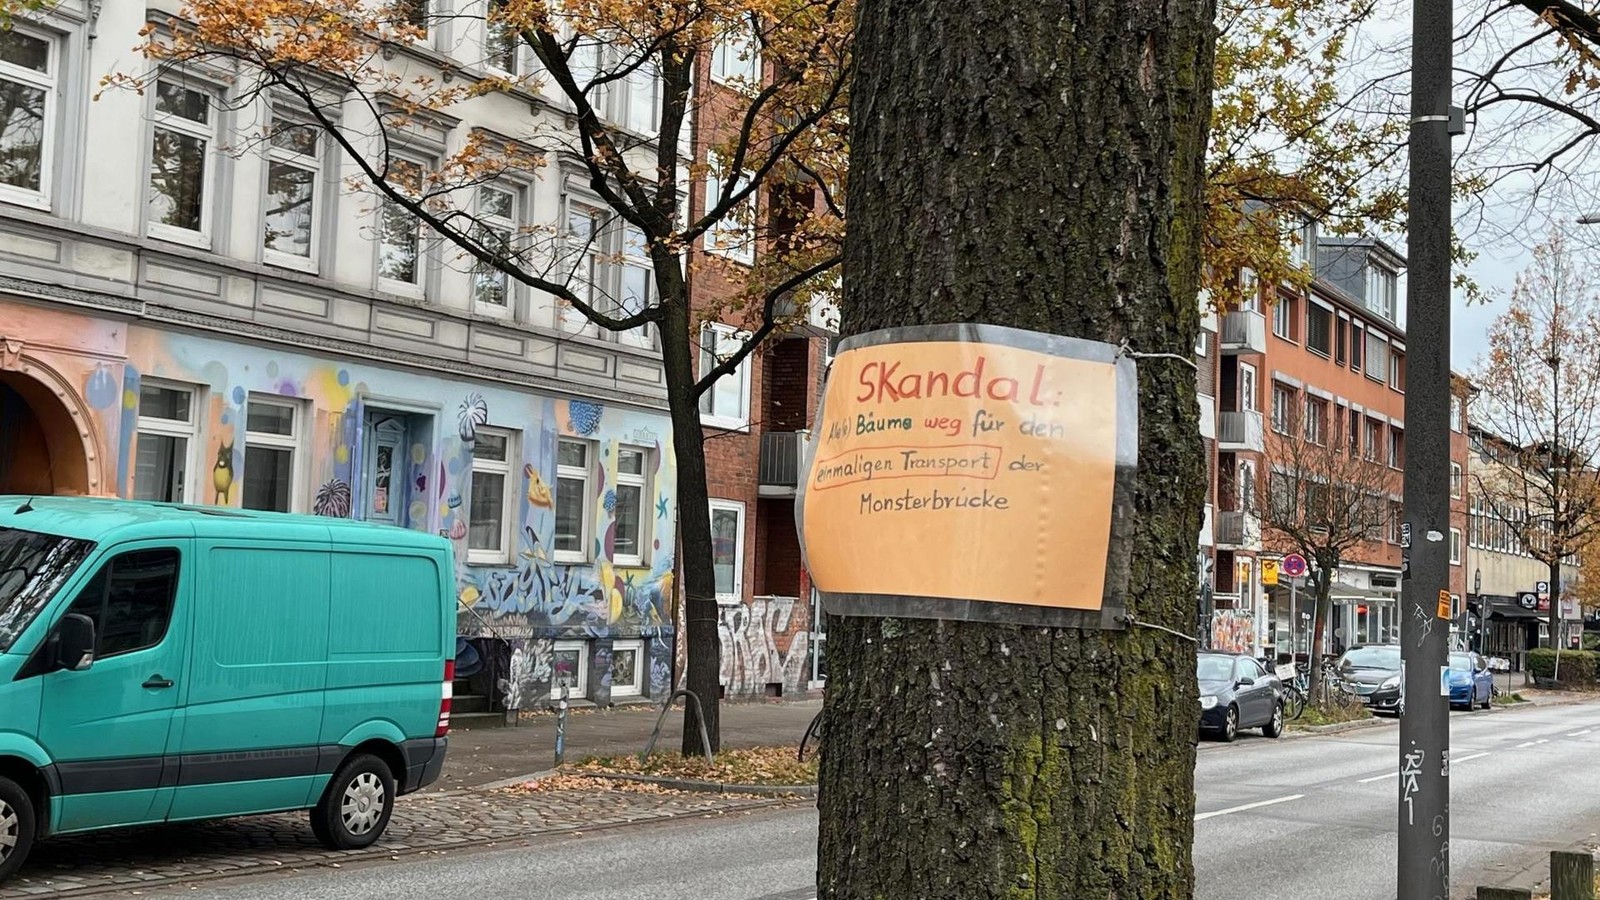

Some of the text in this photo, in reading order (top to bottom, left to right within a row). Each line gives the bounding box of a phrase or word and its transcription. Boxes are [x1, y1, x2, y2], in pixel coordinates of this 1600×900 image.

[855, 411, 913, 436] Bäume
[924, 416, 962, 437] weg
[972, 409, 1005, 437] für
[1018, 413, 1064, 439] den
[816, 450, 1045, 482] einmaligen Transport der
[859, 487, 1009, 515] Monsterbrücke
